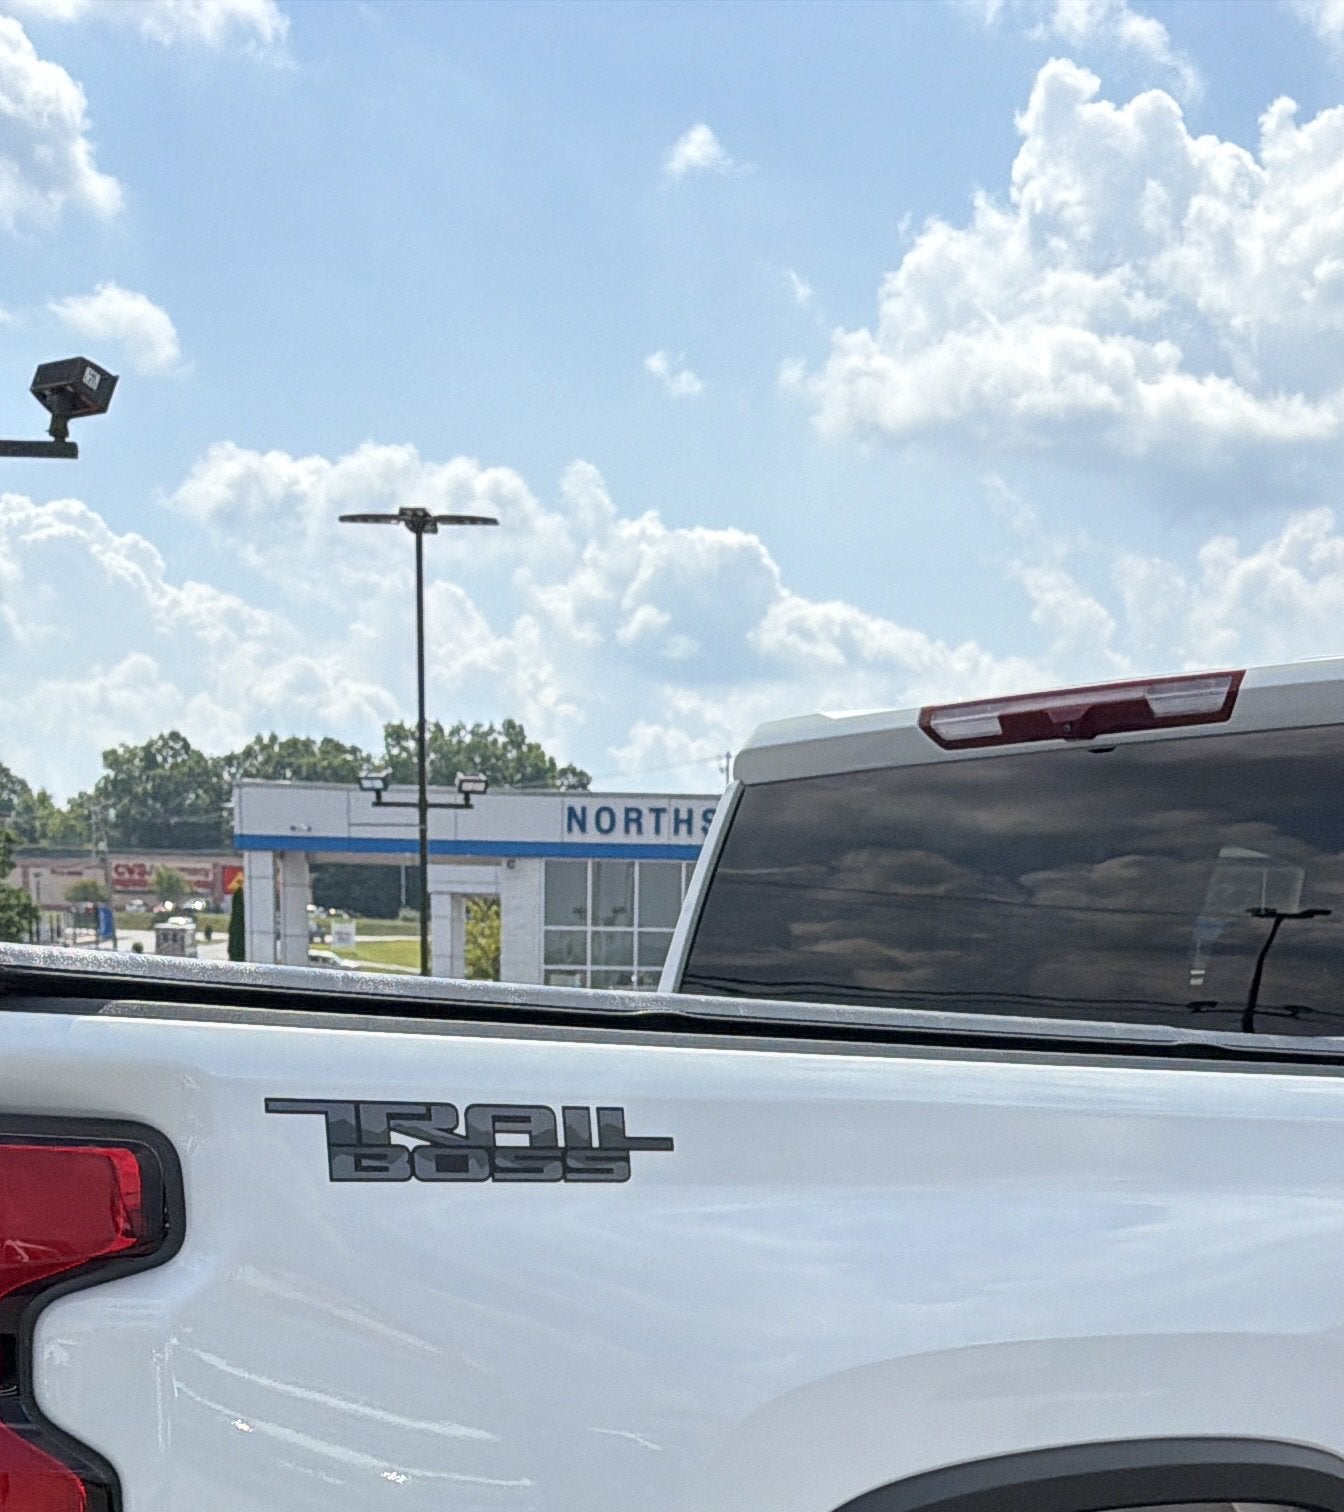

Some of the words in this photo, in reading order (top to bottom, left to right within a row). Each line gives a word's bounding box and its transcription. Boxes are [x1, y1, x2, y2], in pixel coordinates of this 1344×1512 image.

[113, 863, 147, 877] CVS
[264, 1097, 674, 1152] TRAIL
[329, 1144, 631, 1183] BOSS
